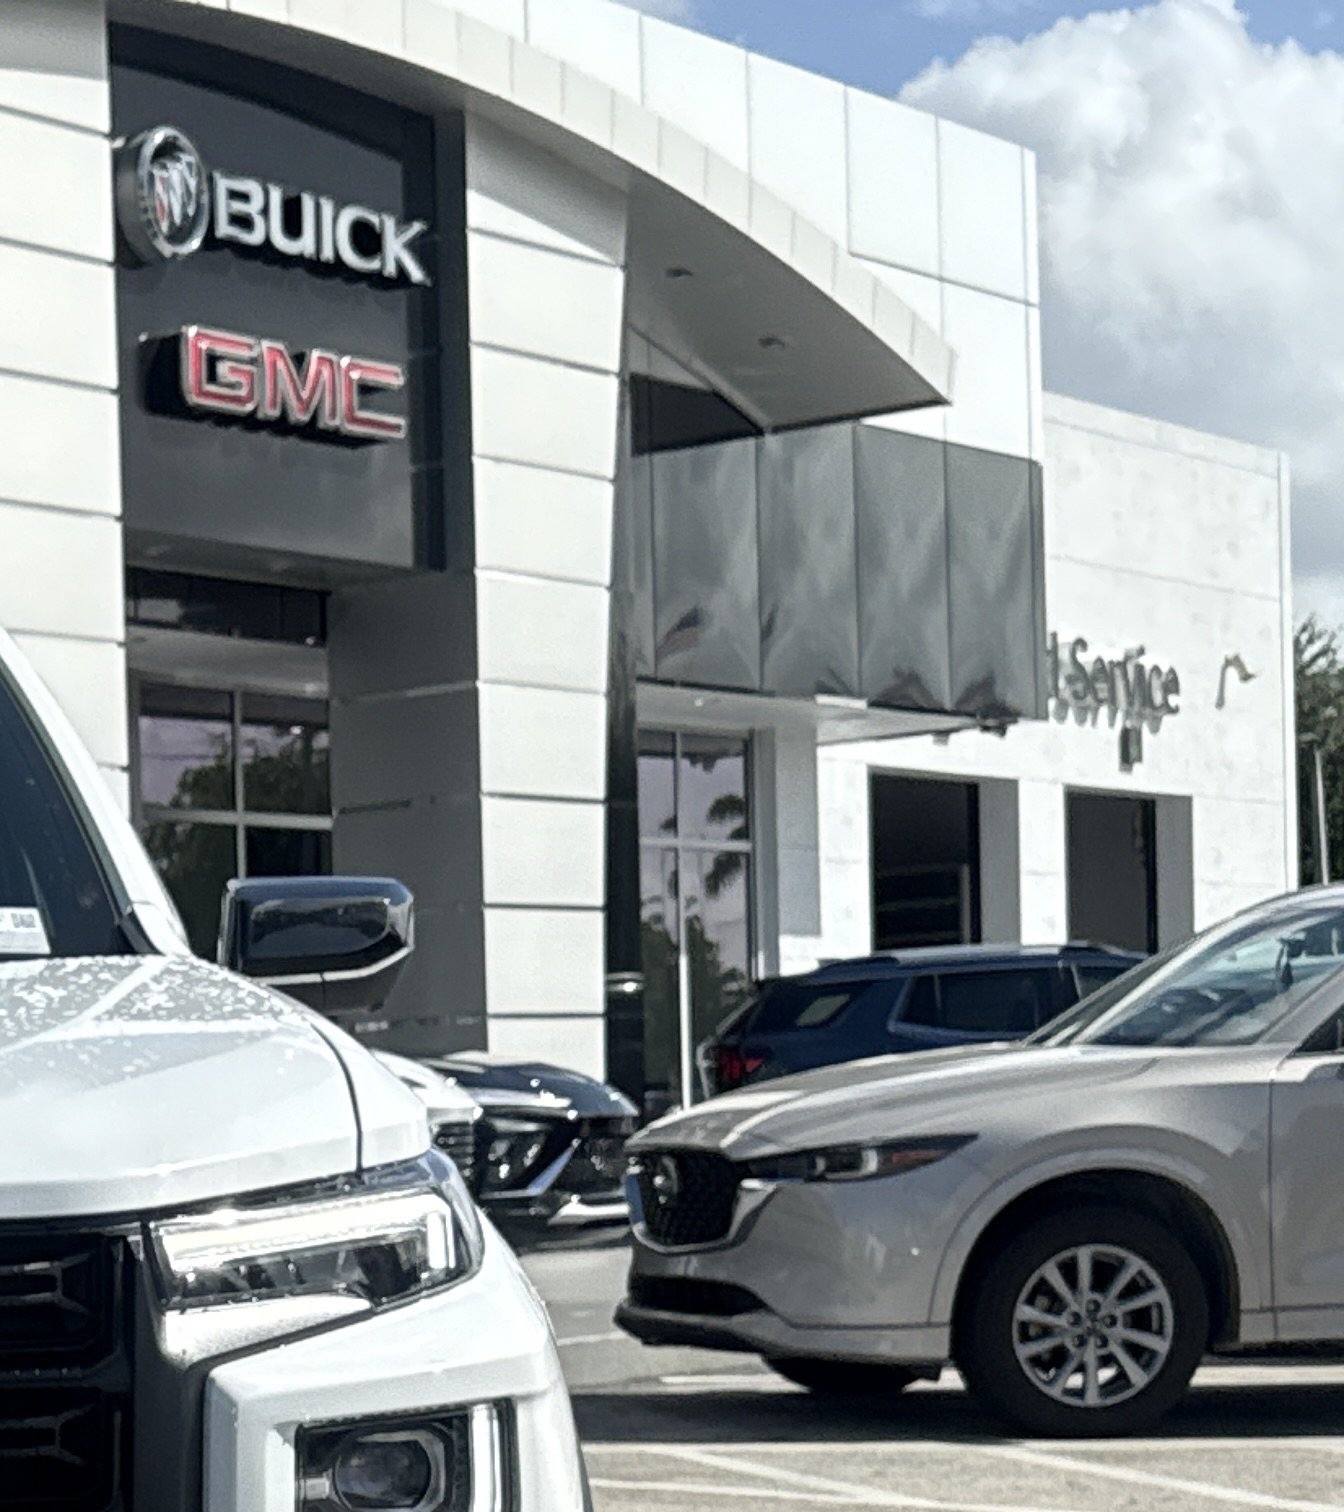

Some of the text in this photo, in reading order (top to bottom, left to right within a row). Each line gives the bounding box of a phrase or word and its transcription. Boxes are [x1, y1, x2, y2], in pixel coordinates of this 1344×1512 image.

[213, 170, 431, 286] BUICK
[182, 324, 406, 439] GMC
[1065, 637, 1180, 714] Service
